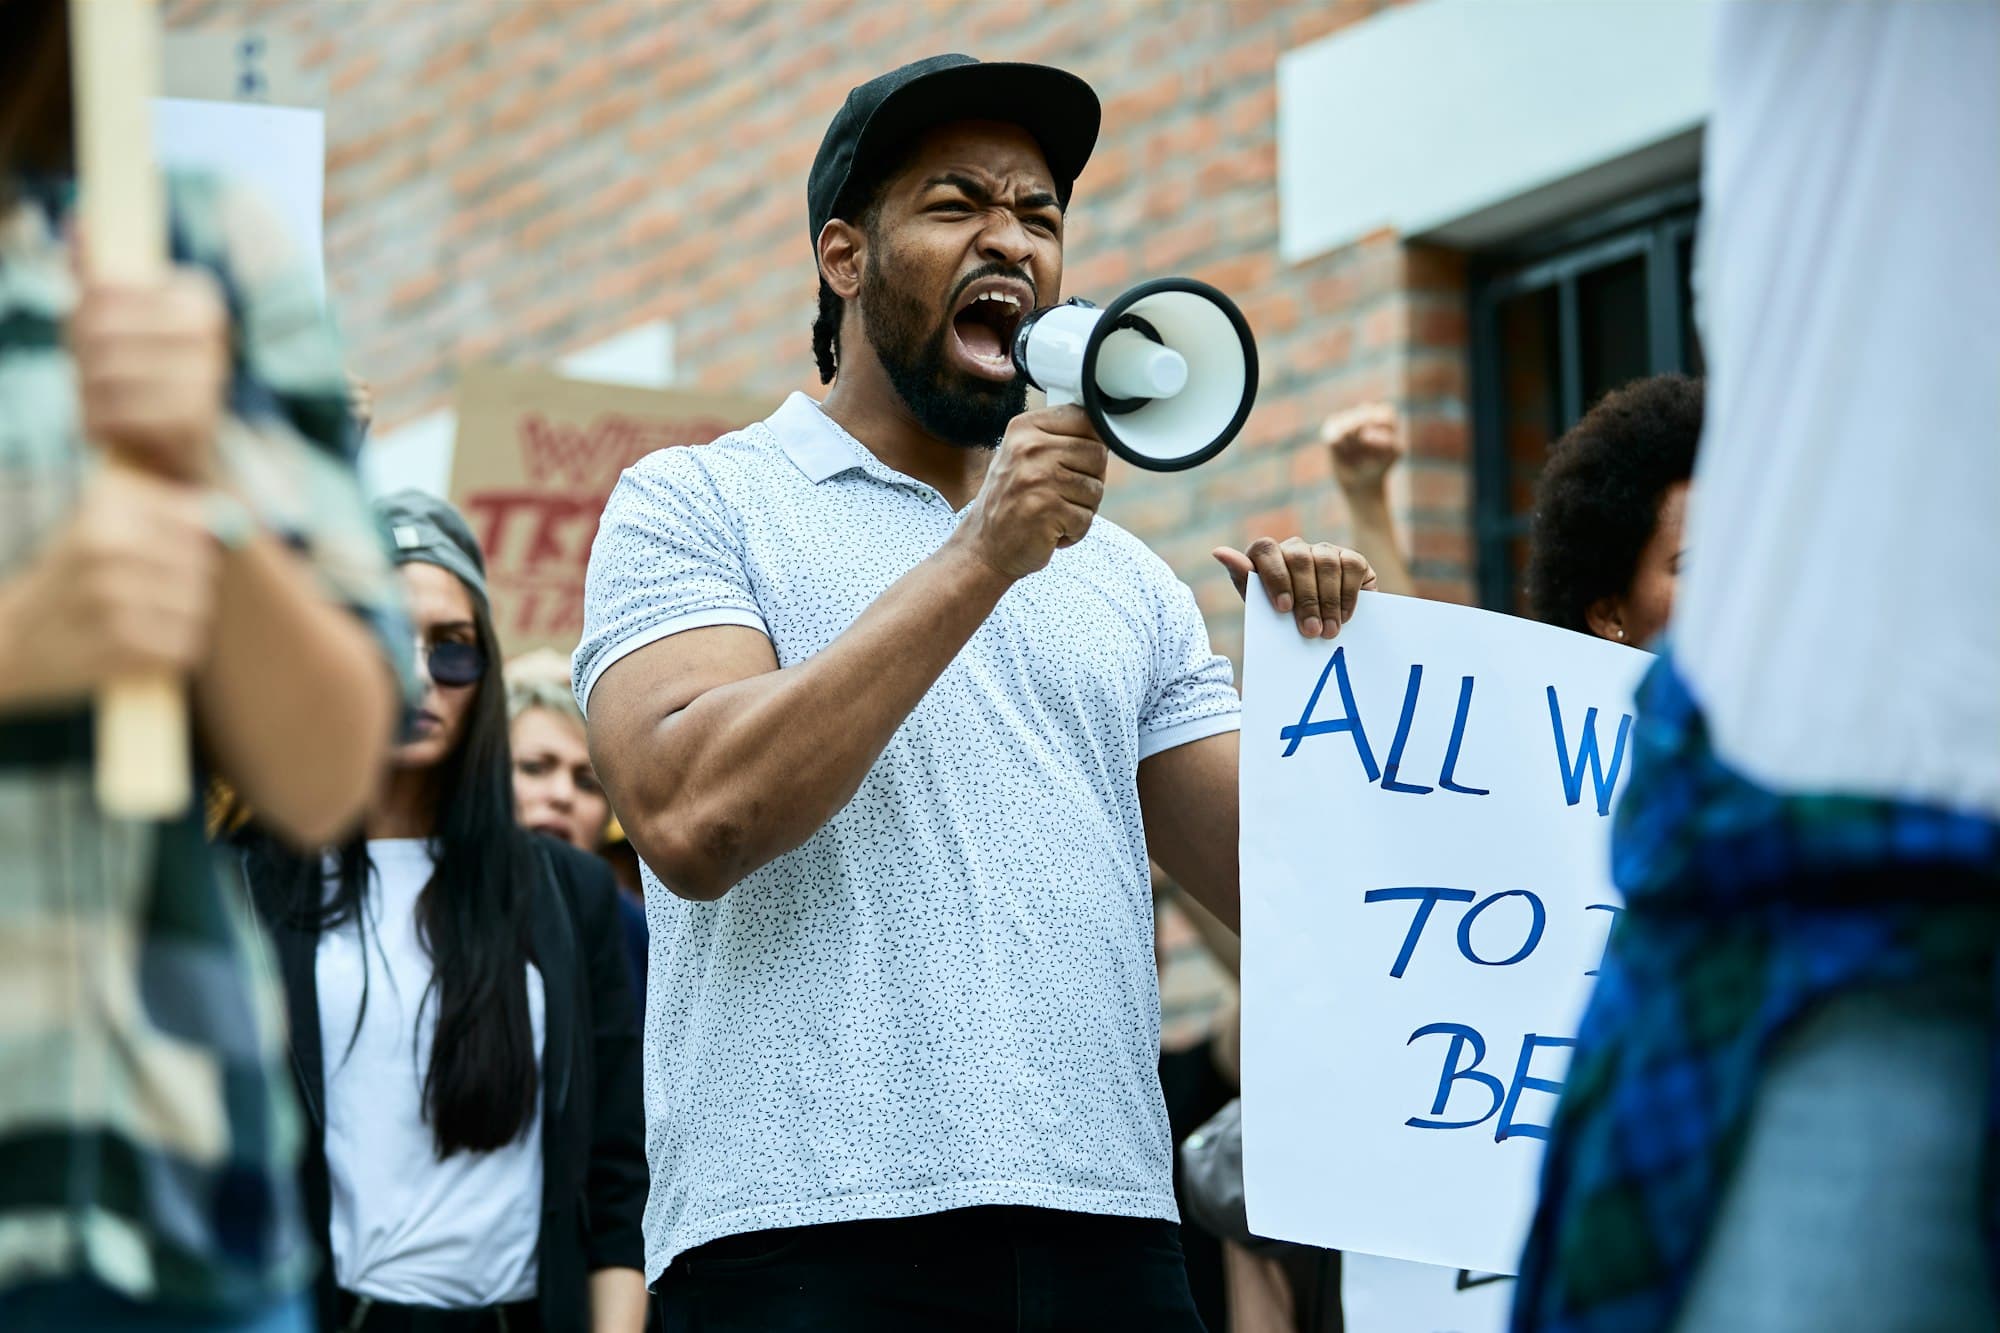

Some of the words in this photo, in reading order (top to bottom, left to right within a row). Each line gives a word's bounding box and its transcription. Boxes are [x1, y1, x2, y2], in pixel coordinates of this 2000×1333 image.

[1280, 646, 1490, 795] ALL
[1364, 887, 1546, 979] TO
[1404, 1022, 1577, 1143] BE
